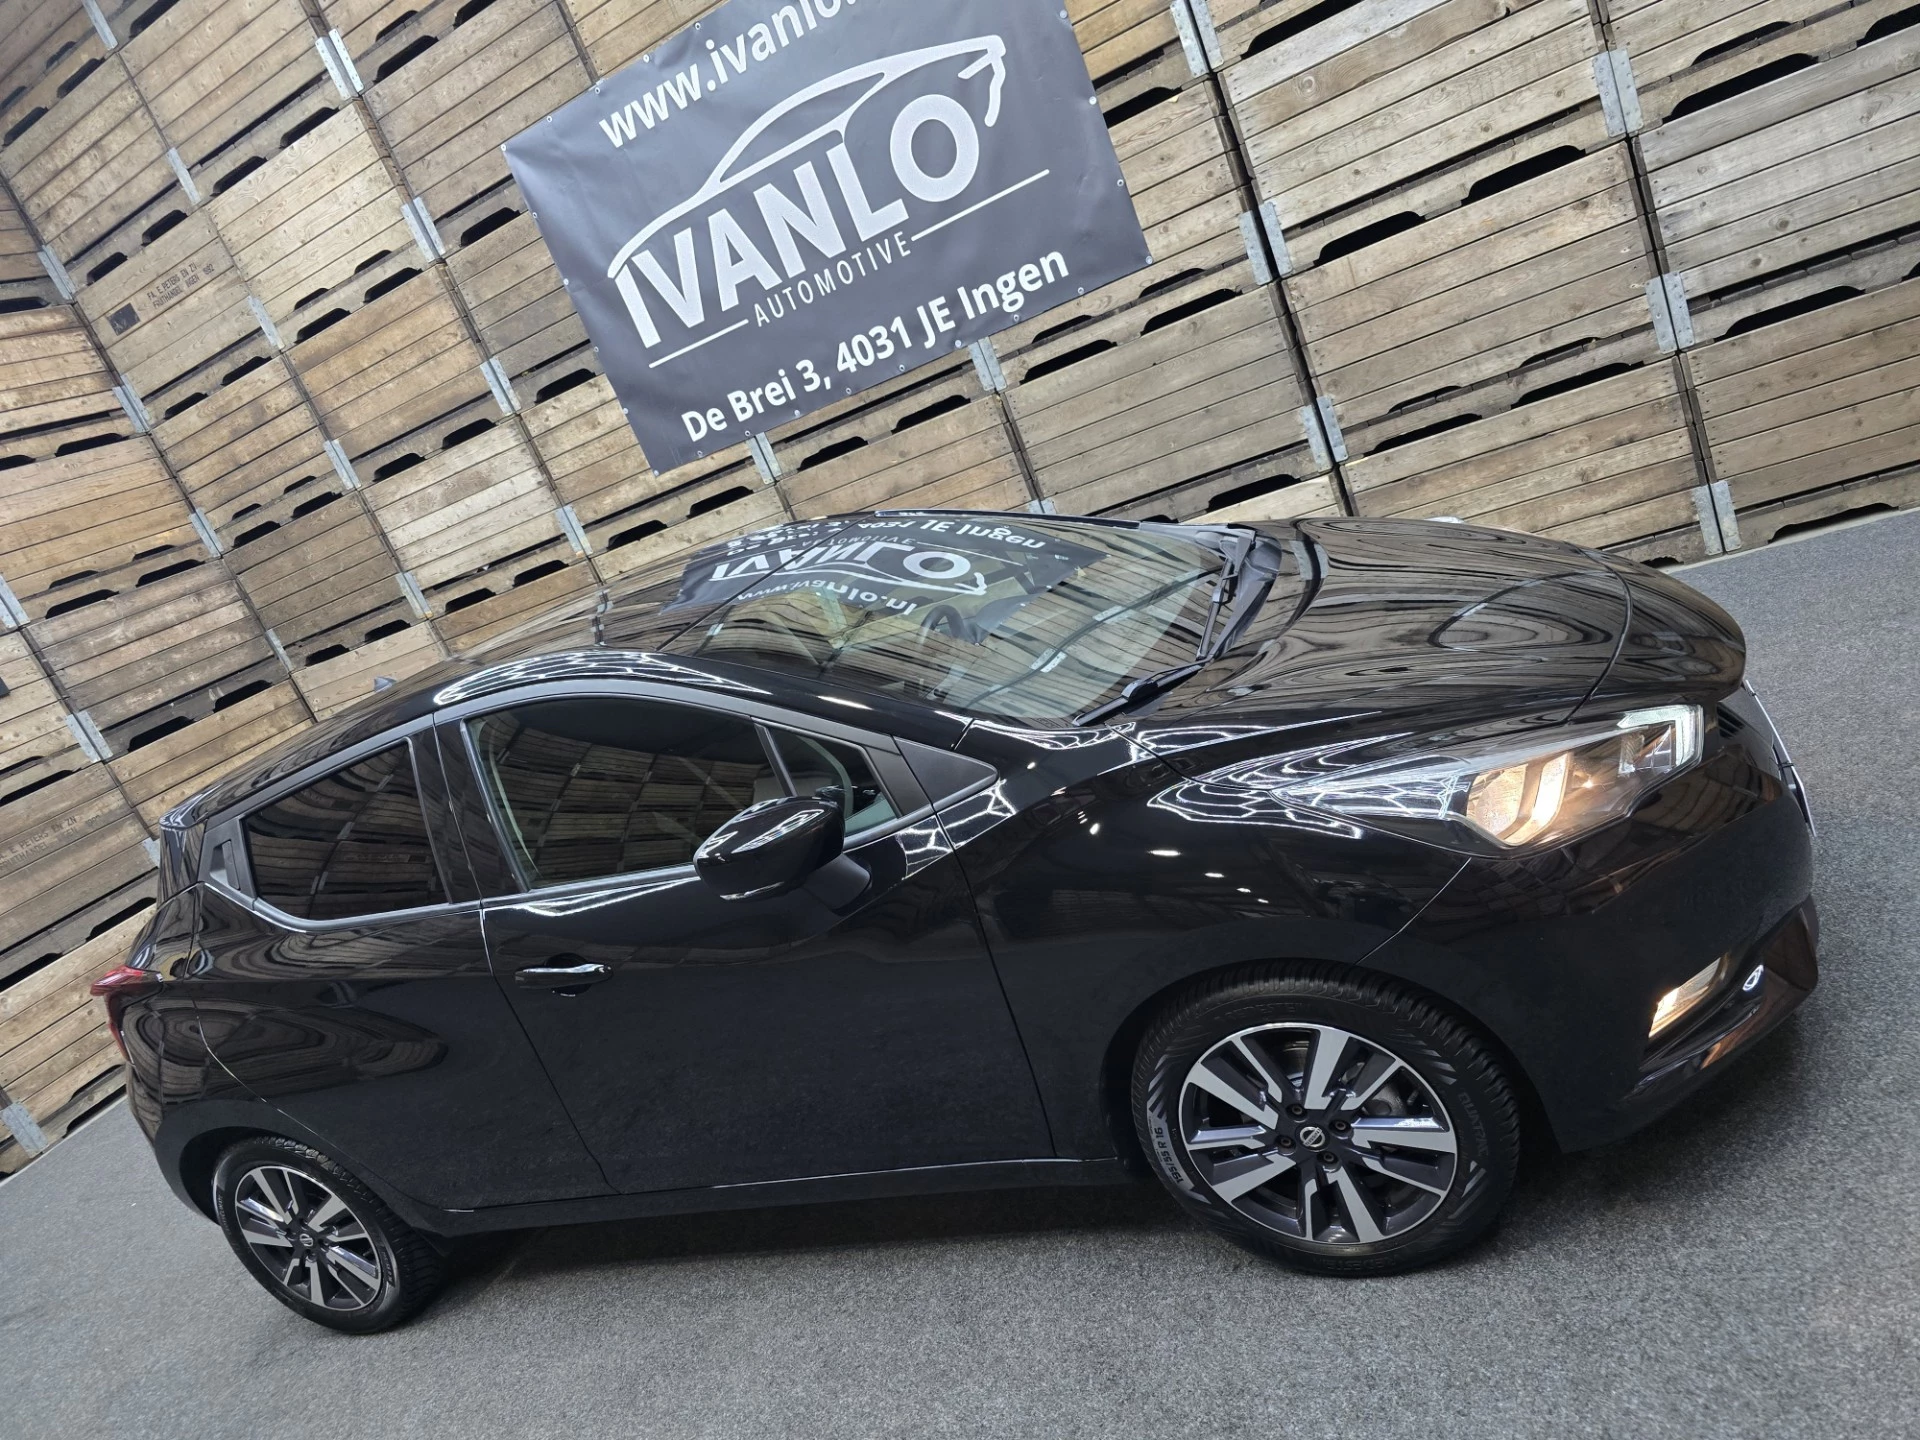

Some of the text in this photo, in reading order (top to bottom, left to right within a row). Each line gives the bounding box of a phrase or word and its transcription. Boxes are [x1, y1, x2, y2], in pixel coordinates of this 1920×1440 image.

[598, 0, 856, 148] www.ivanlo
[614, 93, 980, 349] IVANLO
[754, 230, 912, 327] AUTOMOTIVE
[681, 250, 1069, 442] De Brei 3, 4031 JE Ingen
[1153, 1127, 1165, 1139] 16
[1157, 1141, 1168, 1149] R
[1160, 1150, 1185, 1183] 195/55
